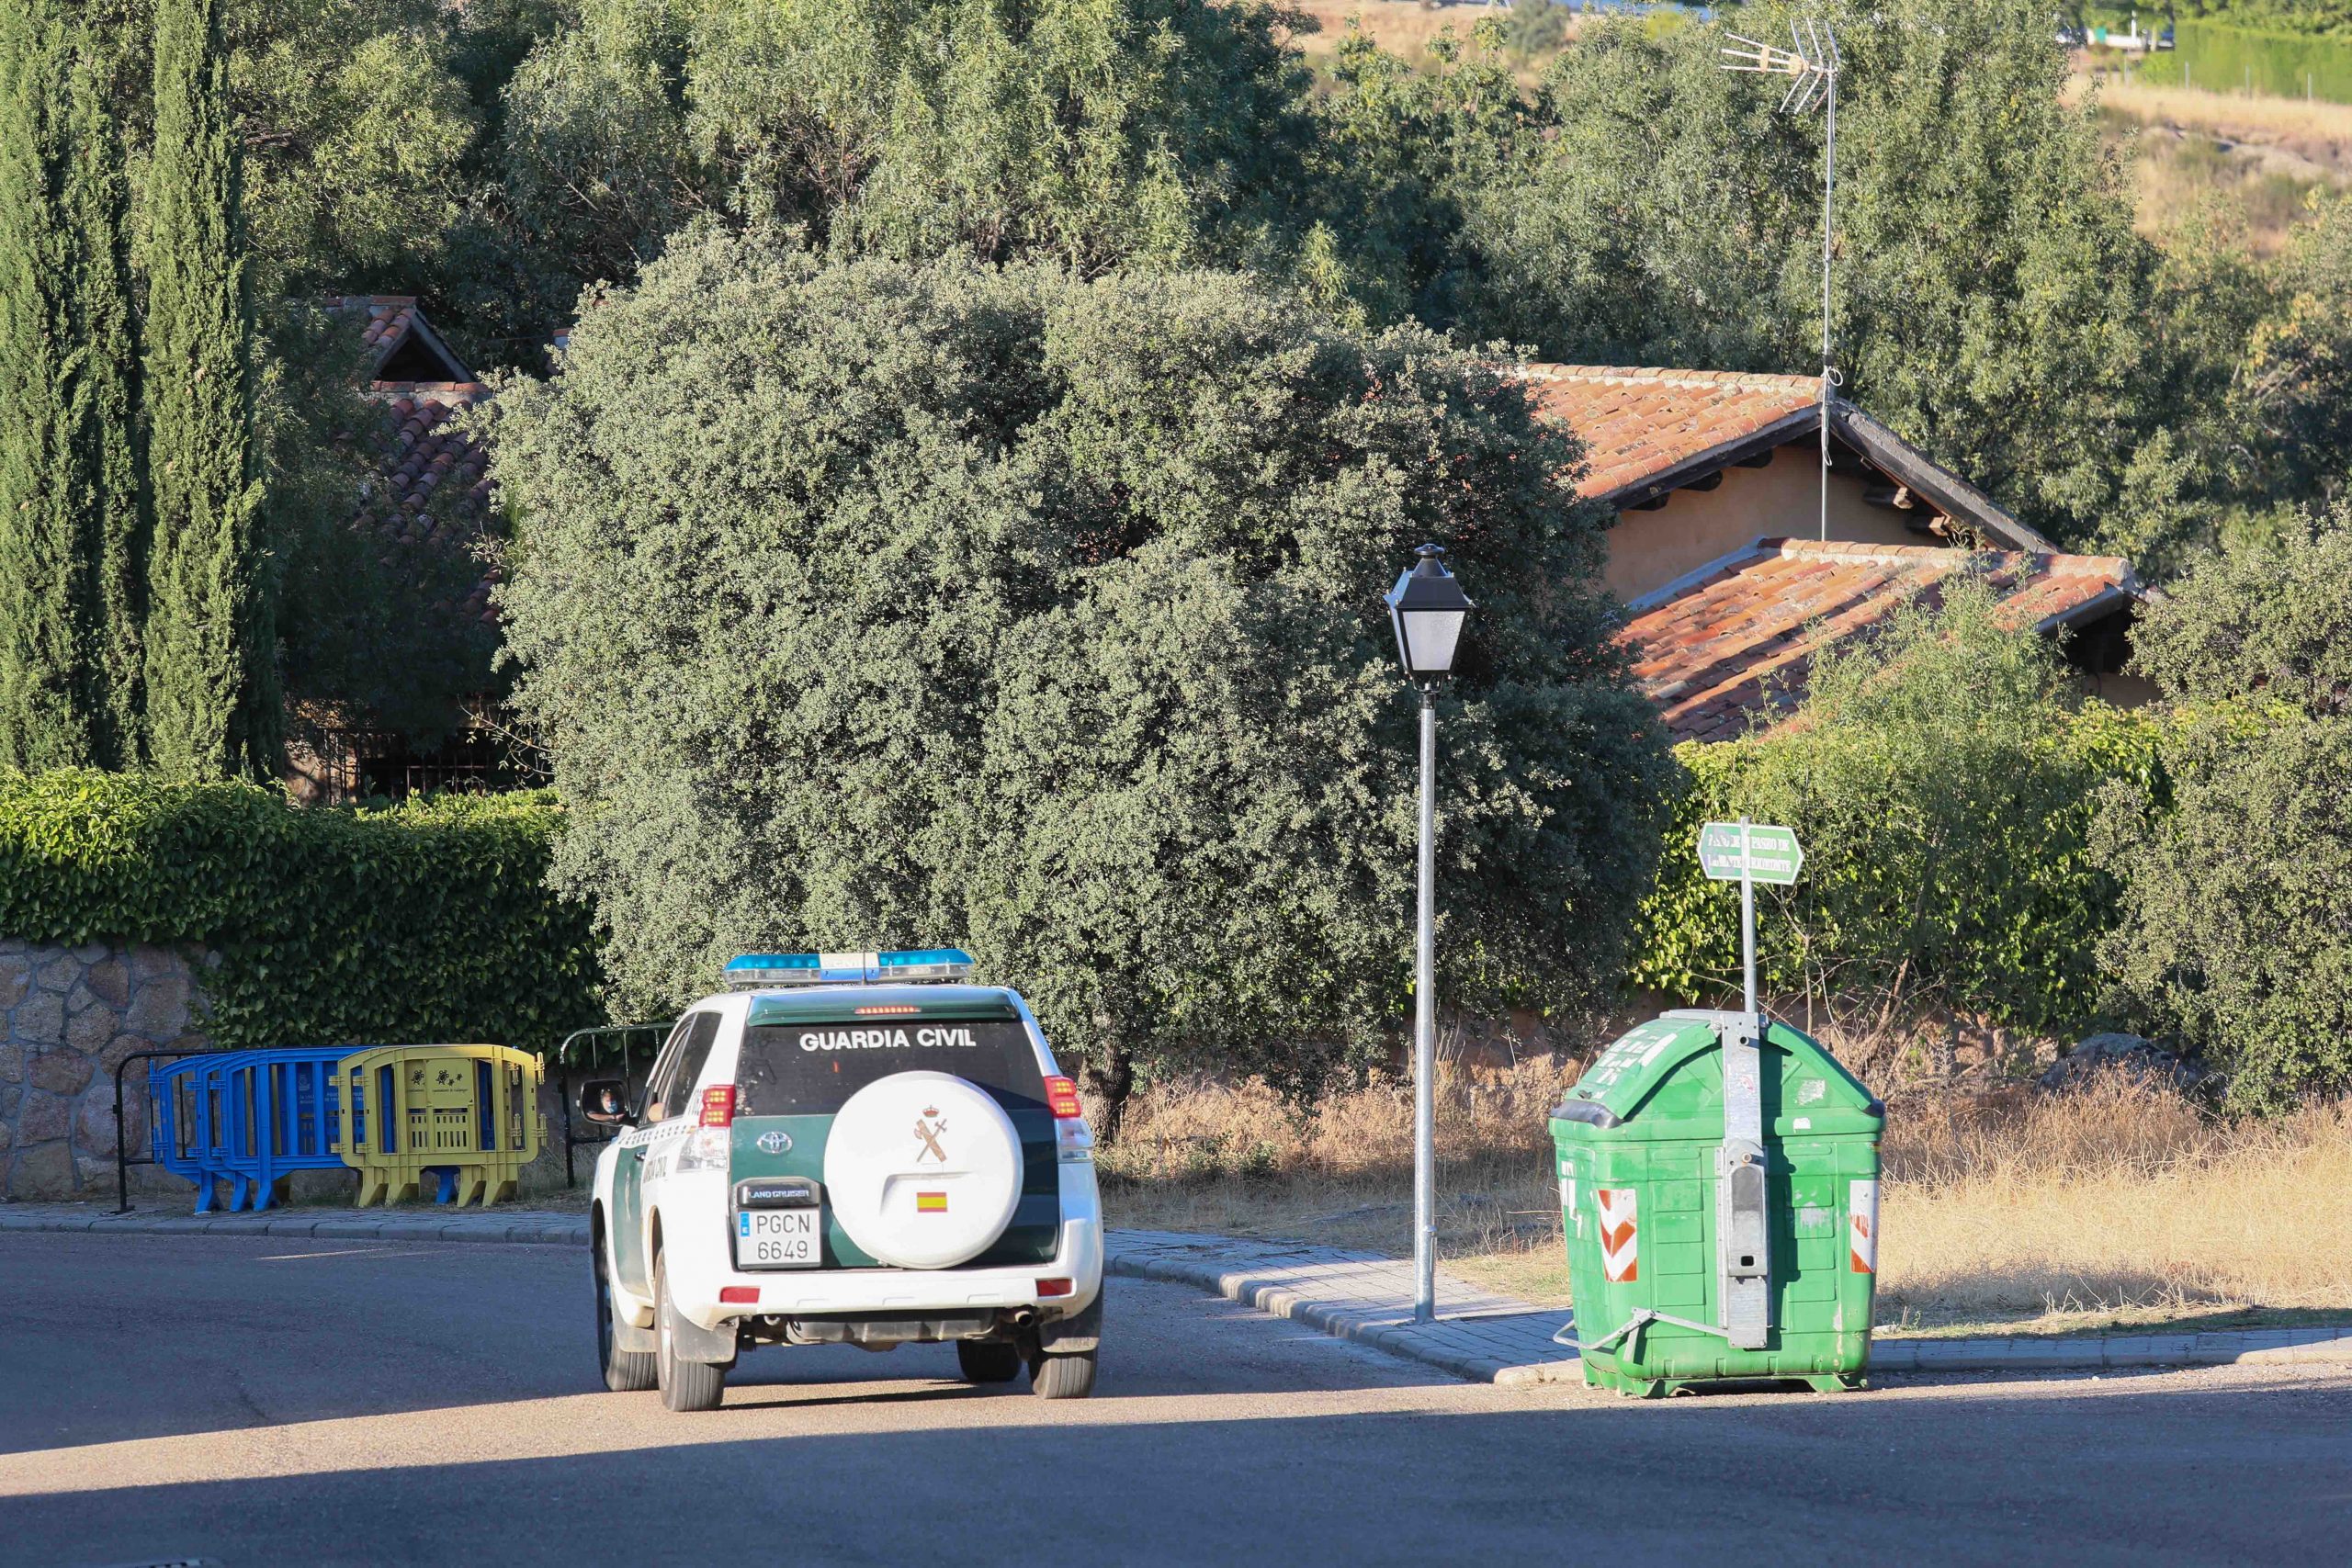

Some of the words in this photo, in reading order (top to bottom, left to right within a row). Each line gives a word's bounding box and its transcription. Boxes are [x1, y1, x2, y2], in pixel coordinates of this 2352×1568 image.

[799, 1029, 910, 1052] GUARDIA
[917, 1029, 977, 1047] CIVIL
[749, 1190, 772, 1199] LAND
[773, 1190, 809, 1198] CRUISER
[756, 1213, 810, 1234] PGCN
[757, 1240, 808, 1260] 6649
